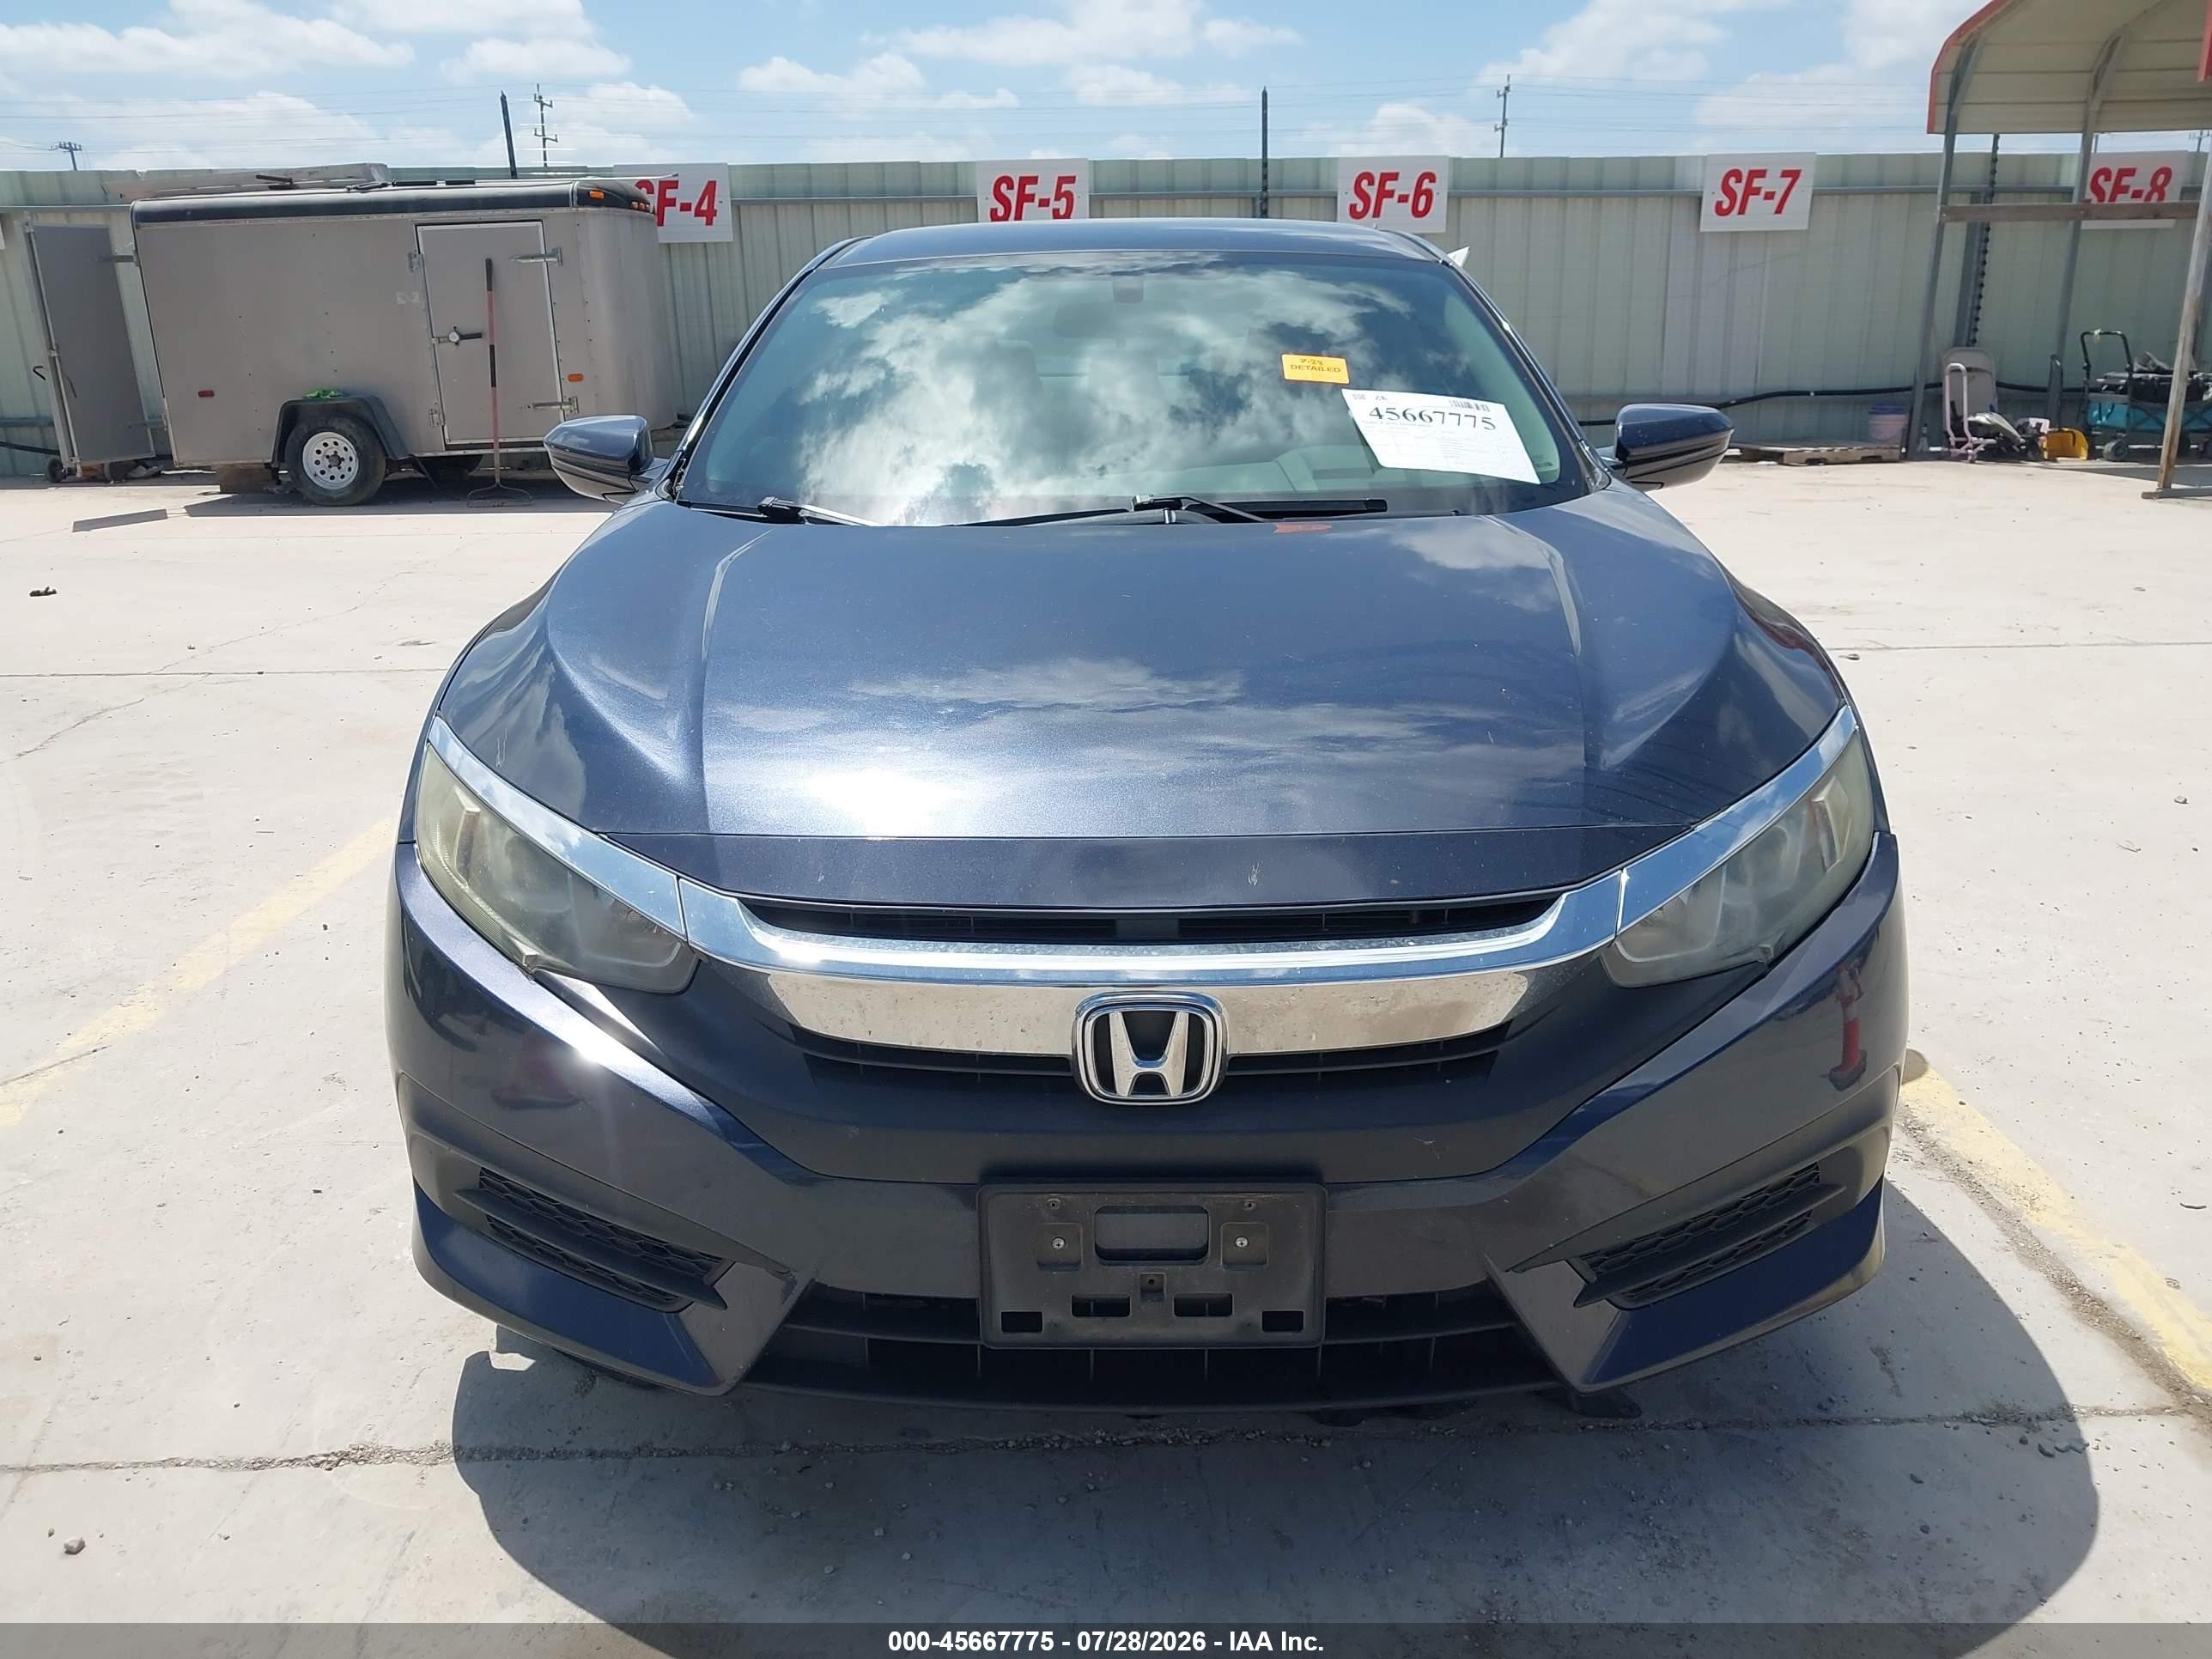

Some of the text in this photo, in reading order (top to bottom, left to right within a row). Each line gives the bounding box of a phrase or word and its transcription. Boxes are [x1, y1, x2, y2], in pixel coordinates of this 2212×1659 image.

[989, 175, 1077, 222] SF-5
[1349, 171, 1437, 220] SF-6
[1715, 168, 1802, 216] SF-7
[2089, 167, 2173, 203] SF-8
[1290, 364, 1341, 373] DETAILED
[1369, 406, 1497, 431] 45667775
